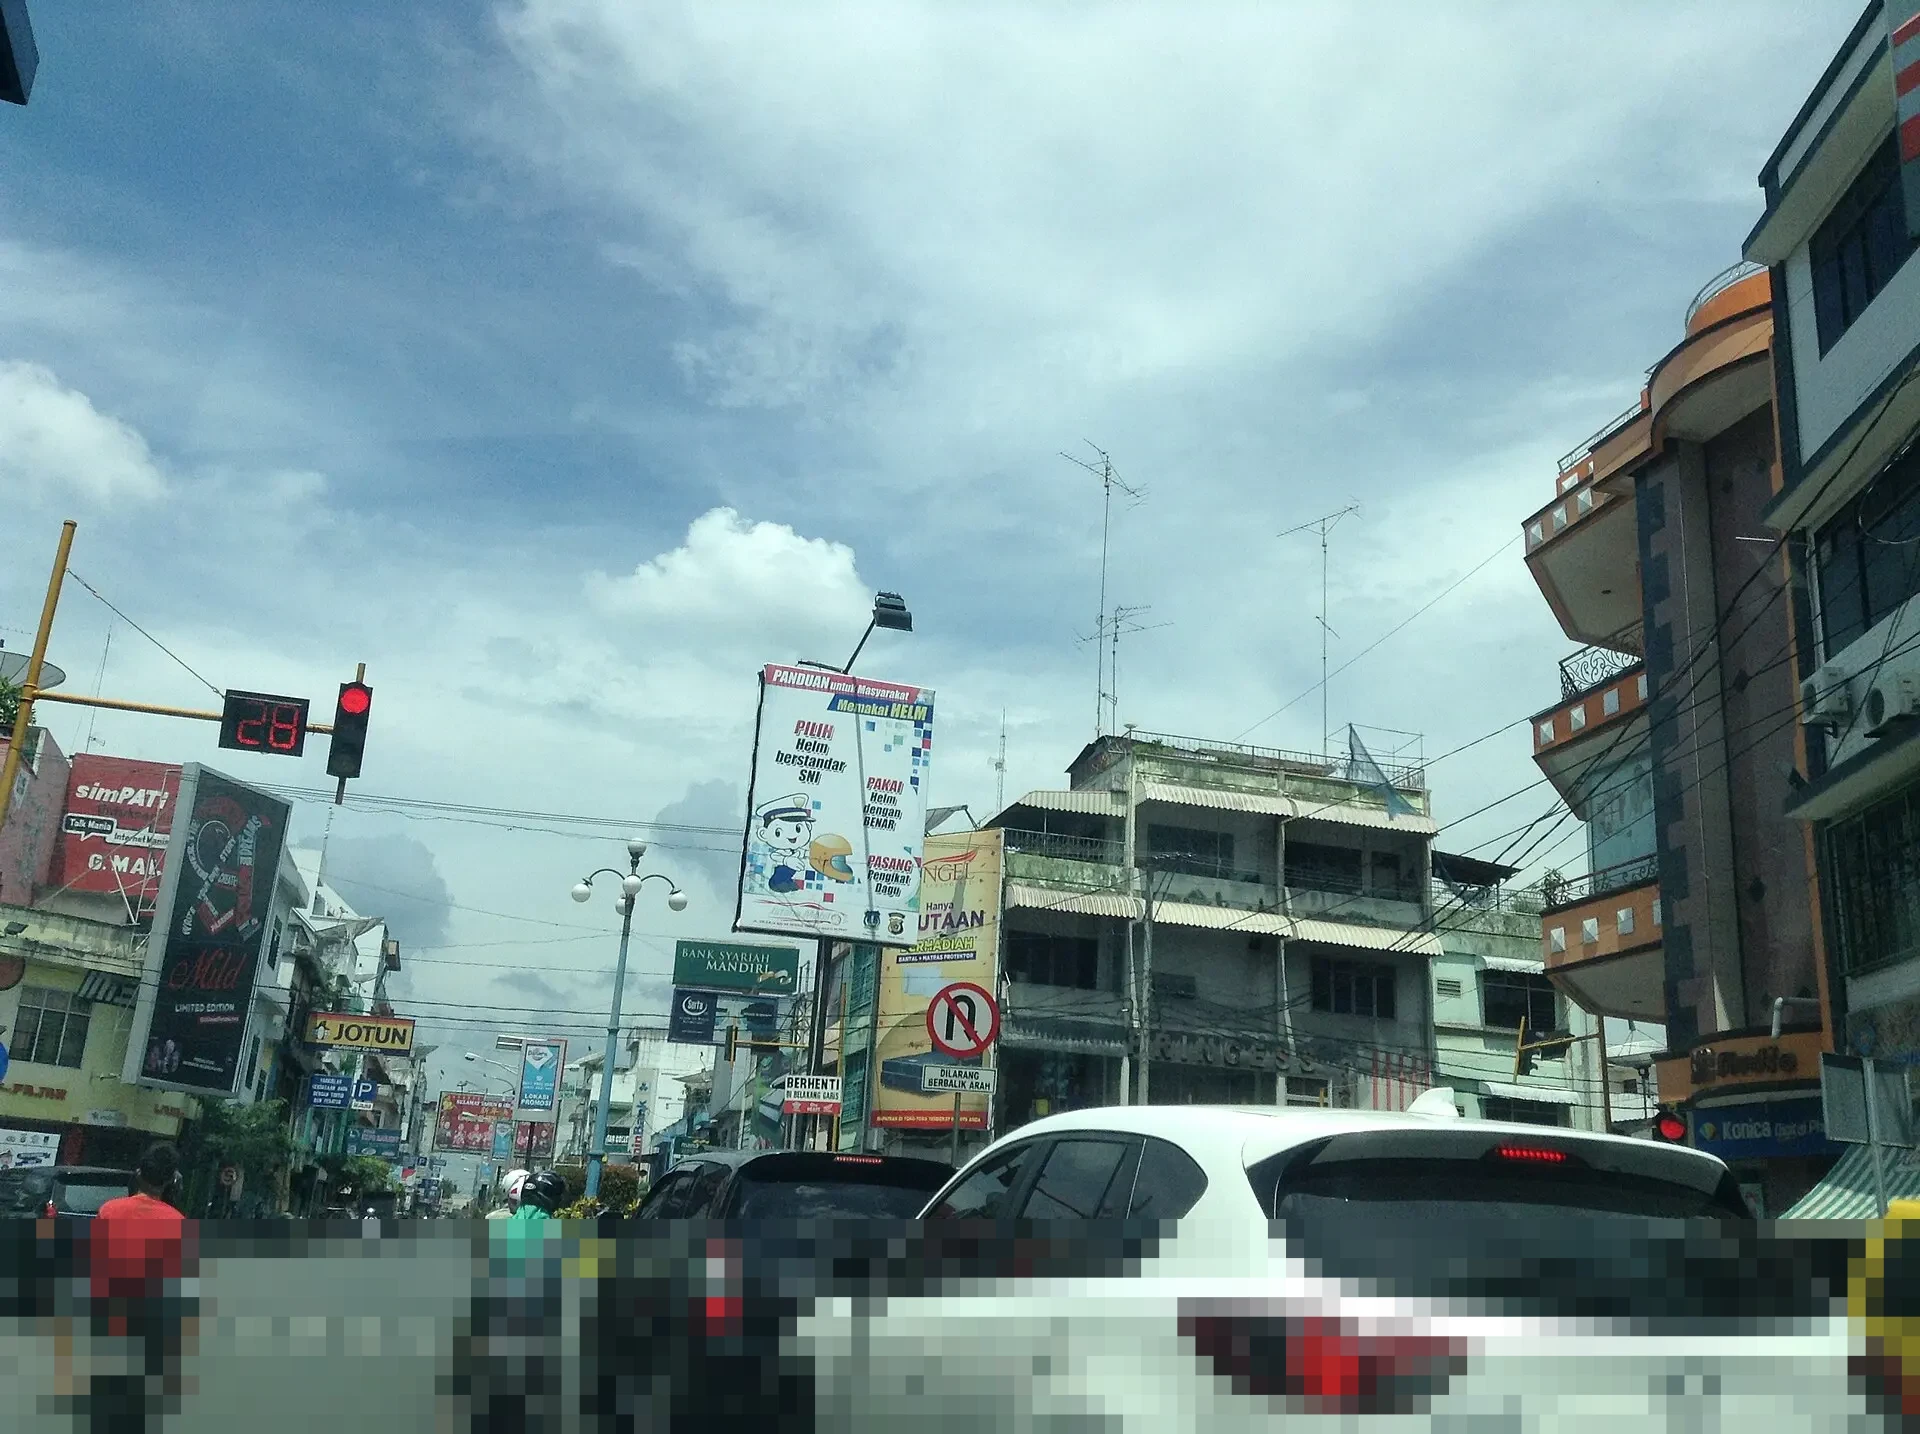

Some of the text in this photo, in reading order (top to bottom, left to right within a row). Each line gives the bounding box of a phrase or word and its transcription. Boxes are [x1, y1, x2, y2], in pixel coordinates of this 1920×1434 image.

[772, 669, 910, 701] PANDUAN untuk Masyarakat
[837, 699, 928, 721] Memakai HELM
[236, 700, 300, 749] 28
[794, 719, 834, 739] PILIH
[795, 737, 829, 755] Helm
[775, 750, 847, 772] berstandar
[799, 769, 822, 785] SNI
[867, 777, 905, 794] PAKAI
[870, 791, 898, 806] Helm
[863, 804, 902, 819] dengan
[70, 819, 112, 831] Talk Mania
[863, 817, 897, 831] BENAR
[114, 832, 146, 843] Internet
[868, 855, 913, 873] PASANG
[867, 870, 911, 885] Pengikat
[923, 862, 974, 883] NGEL
[875, 883, 902, 897] Dagu
[926, 902, 954, 911] Hanya
[918, 910, 985, 931] UTAAN
[682, 948, 770, 963] BANK SYARIAH
[706, 961, 769, 974] MANDIRI
[175, 1003, 235, 1012] LIMITED EDITION
[334, 1023, 407, 1045] JOTUN
[940, 1069, 979, 1080] DILARANG
[358, 1083, 372, 1097] P
[787, 1077, 840, 1090] BERHENTI
[928, 1079, 990, 1090] BERBALIK ARAH
[794, 1091, 821, 1099] BELAKANG
[521, 1099, 552, 1107] PROMOSI
[1722, 1117, 1771, 1140] Konica
